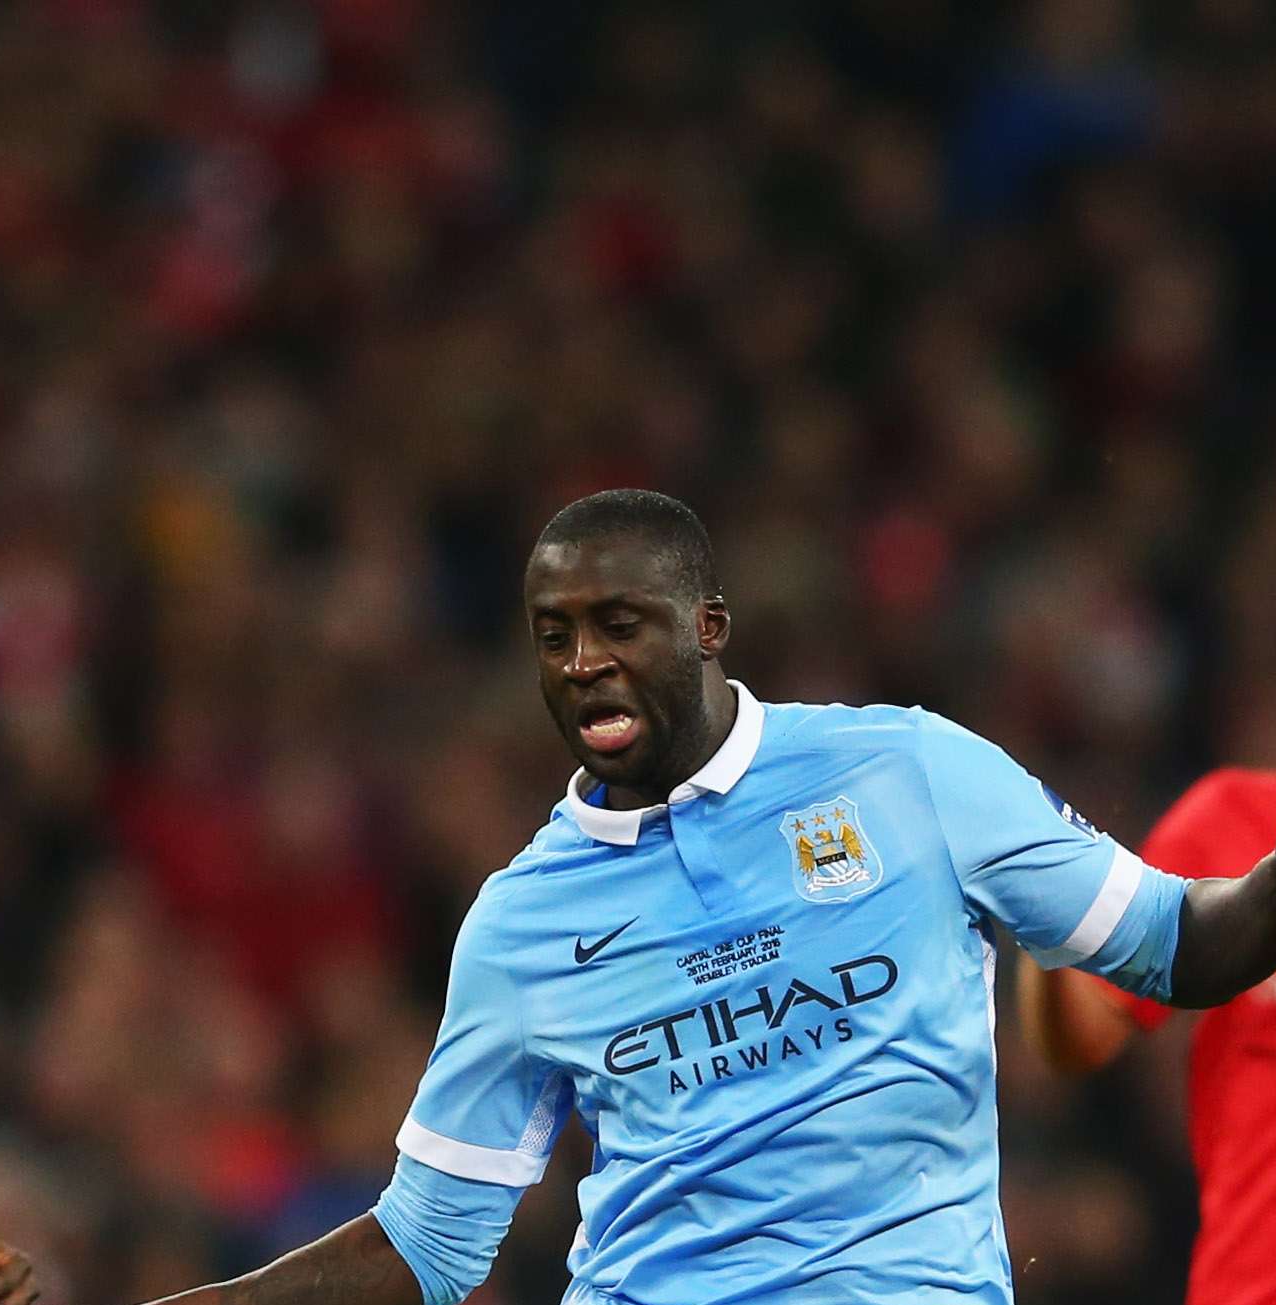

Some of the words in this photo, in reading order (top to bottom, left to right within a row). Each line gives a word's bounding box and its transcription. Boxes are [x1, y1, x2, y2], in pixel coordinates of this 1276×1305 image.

[676, 948, 712, 968] CAPITAL
[714, 943, 734, 956] ONE
[736, 934, 755, 947] CUP
[757, 925, 785, 940] FINAL
[686, 963, 709, 977] 28TH
[711, 945, 757, 968] FEBRUARY
[760, 938, 781, 951] 2016
[693, 964, 738, 986] WEMBLEY
[741, 950, 781, 971] STADIUM
[604, 954, 898, 1075] ETIHAD
[669, 1018, 853, 1095] AIRWAYS
